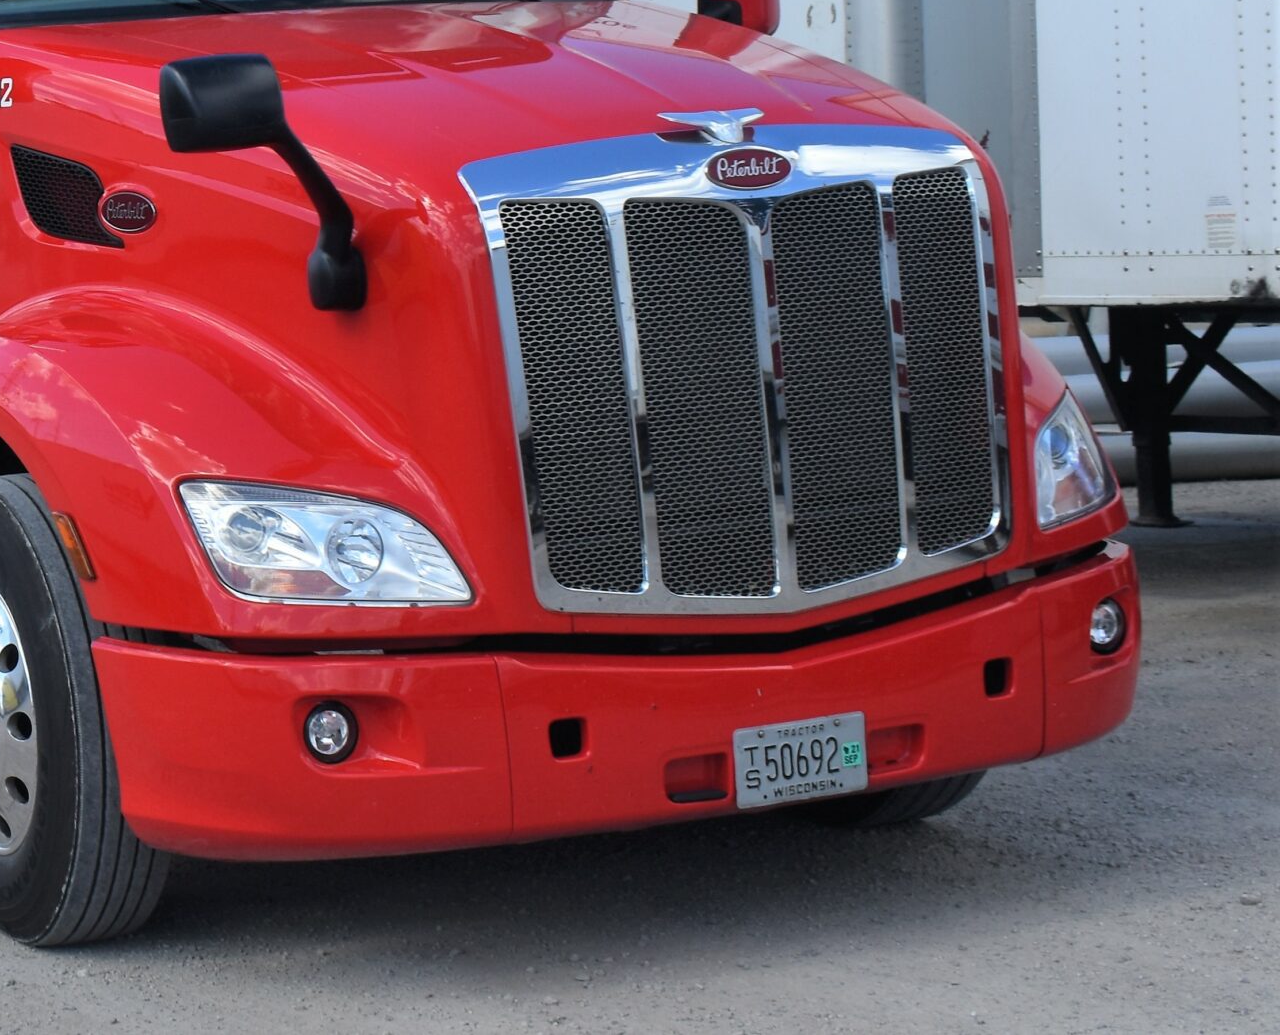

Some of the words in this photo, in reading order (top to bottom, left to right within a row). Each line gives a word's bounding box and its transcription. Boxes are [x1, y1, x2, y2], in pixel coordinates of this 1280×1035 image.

[716, 156, 783, 180] Peterbilt
[106, 198, 149, 220] Peterbilt
[777, 724, 825, 739] TRACTOR
[764, 736, 840, 782] 50692
[844, 754, 858, 764] SEP
[773, 780, 837, 798] WISCONSIN
